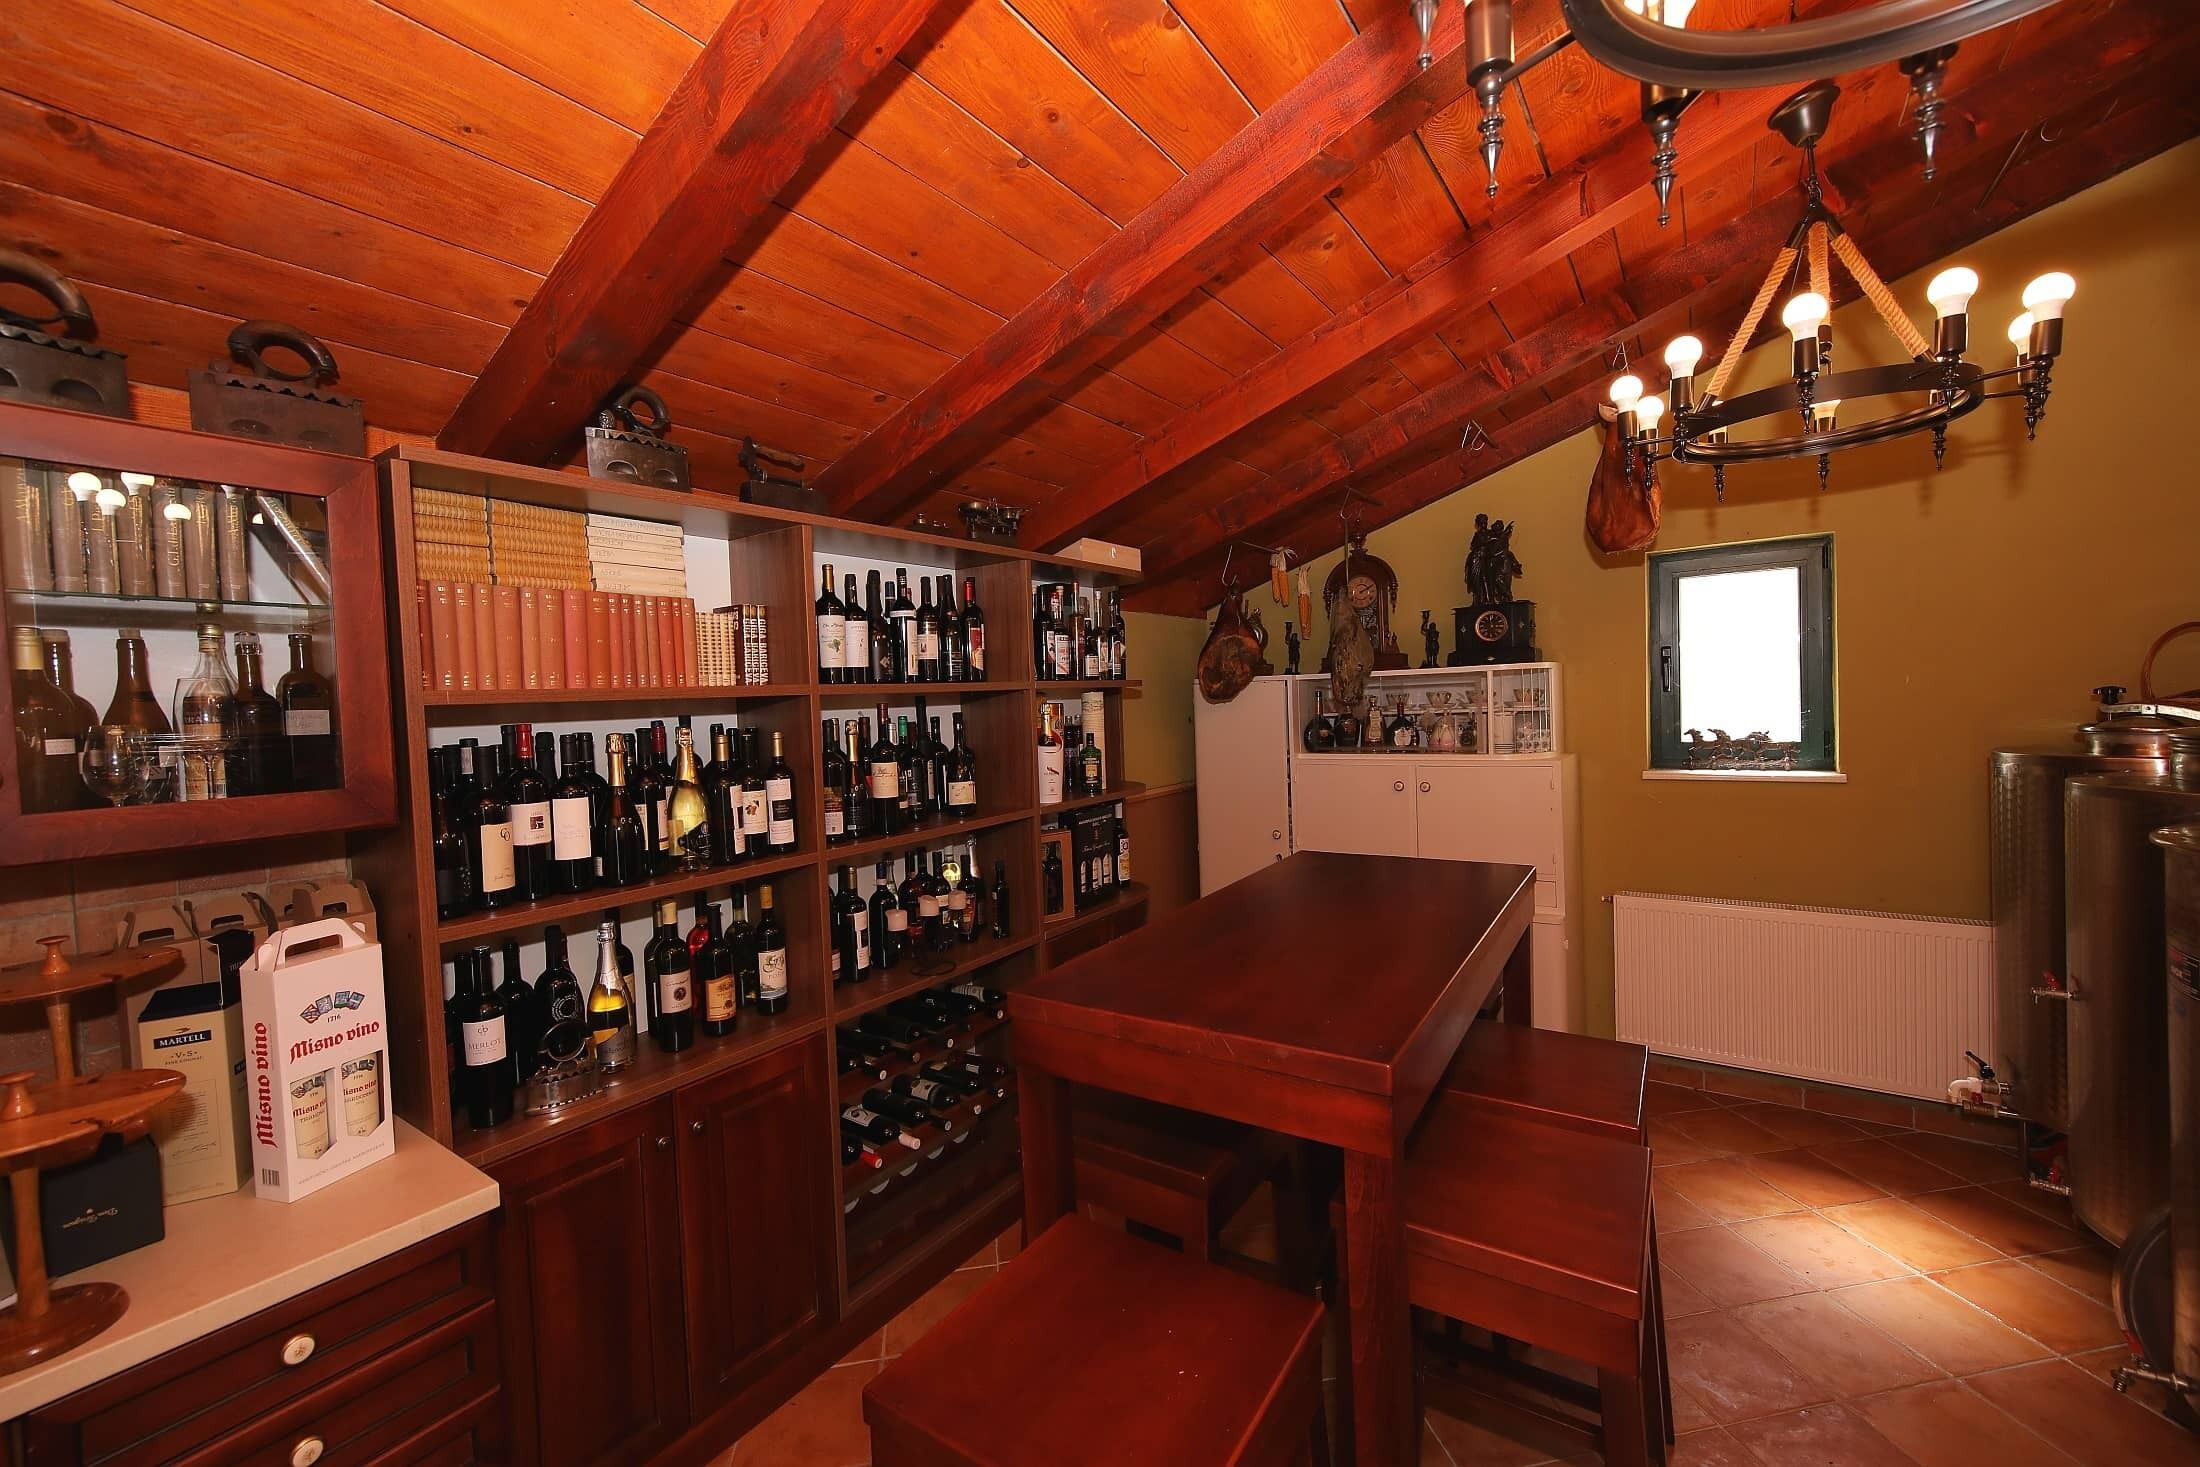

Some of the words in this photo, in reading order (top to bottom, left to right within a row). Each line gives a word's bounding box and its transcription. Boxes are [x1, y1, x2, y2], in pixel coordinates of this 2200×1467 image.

[159, 1033, 207, 1047] MARTELL
[251, 1022, 269, 1070] vino
[289, 1033, 344, 1065] Misno
[346, 1020, 380, 1041] vino
[255, 1074, 278, 1149] Misno
